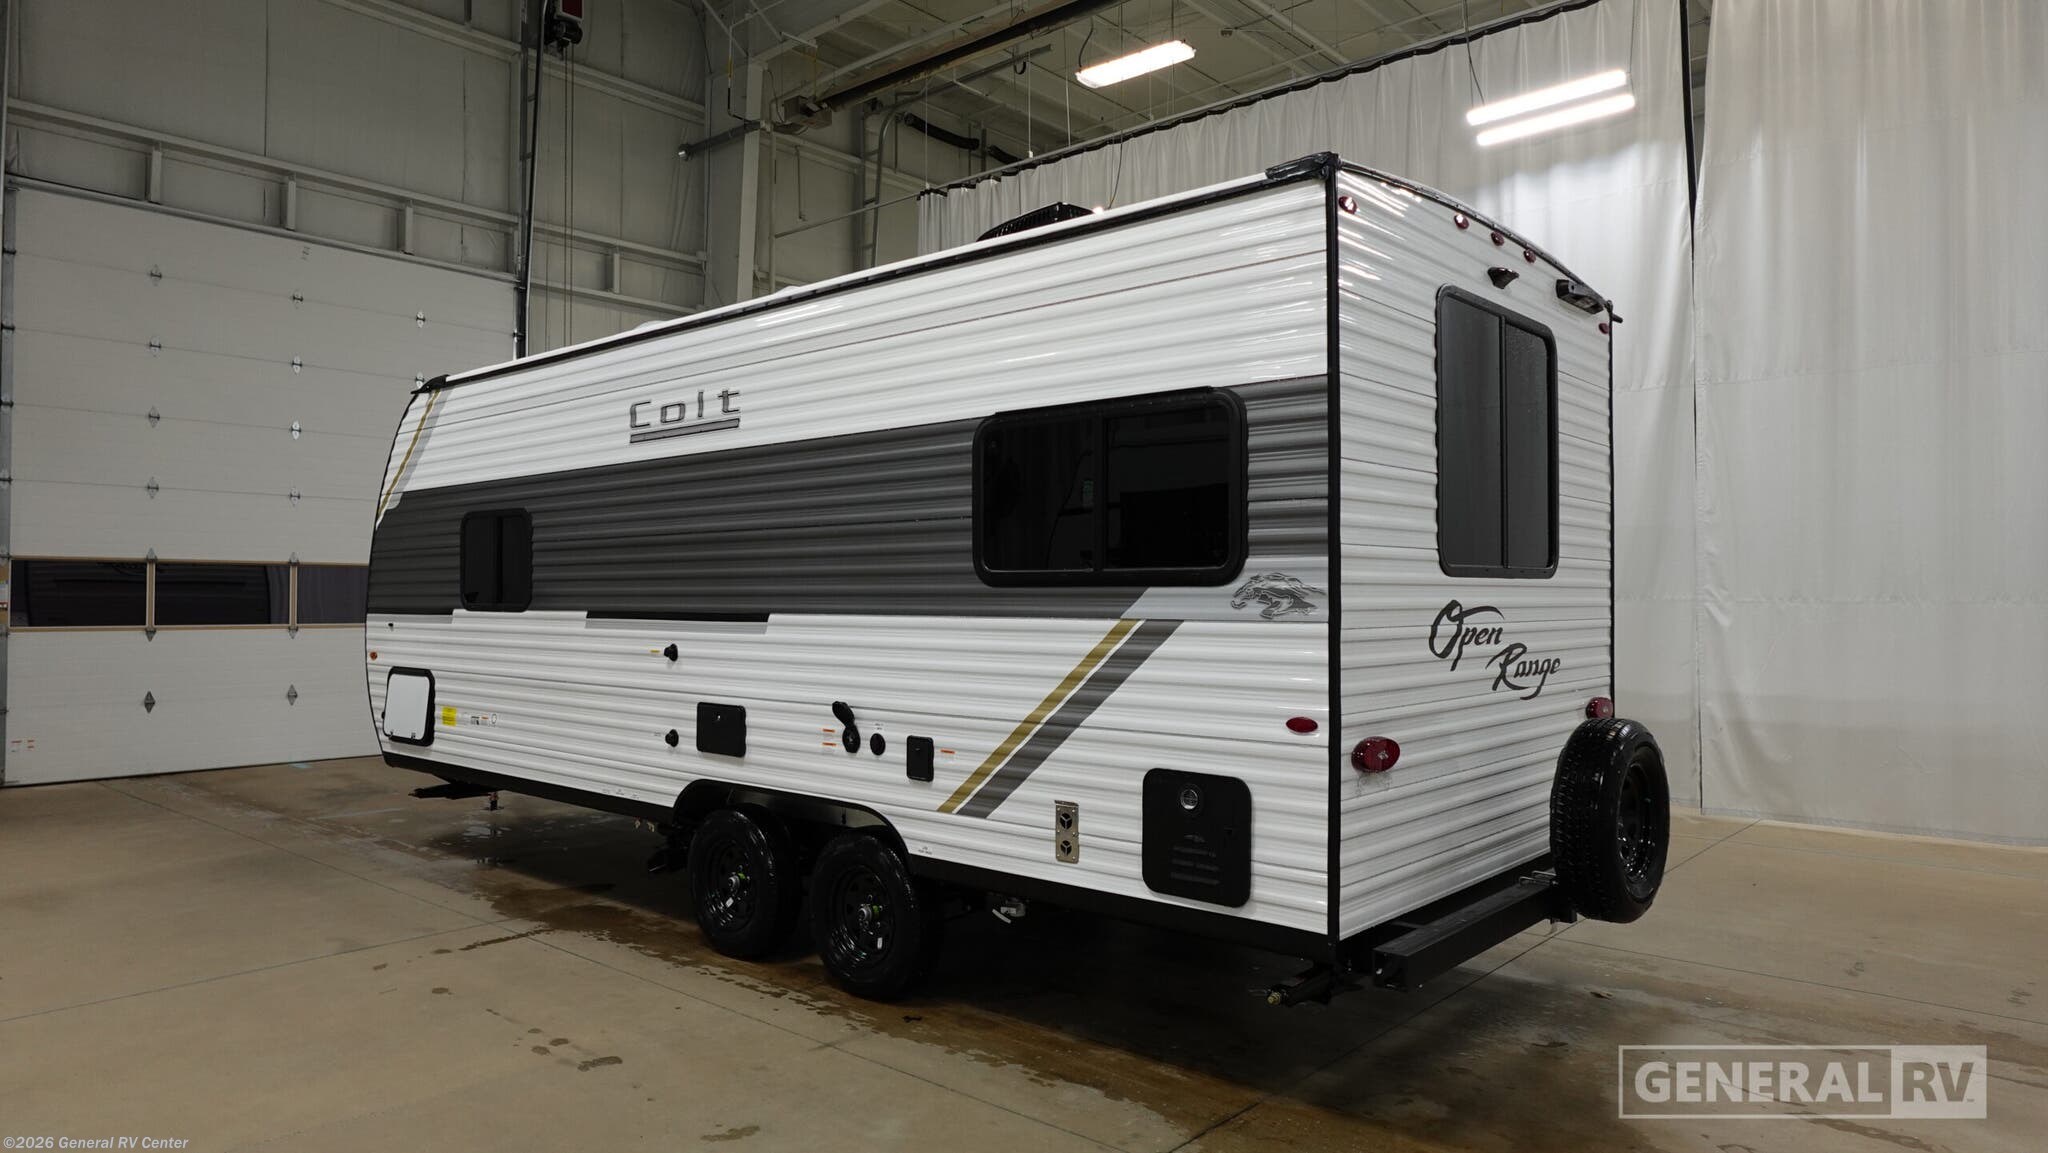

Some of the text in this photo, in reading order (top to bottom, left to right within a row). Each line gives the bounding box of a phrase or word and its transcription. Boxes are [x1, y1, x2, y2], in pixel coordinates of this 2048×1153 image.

[630, 390, 740, 428] Colt
[1429, 600, 1504, 671] Open
[1485, 643, 1561, 700] Range
